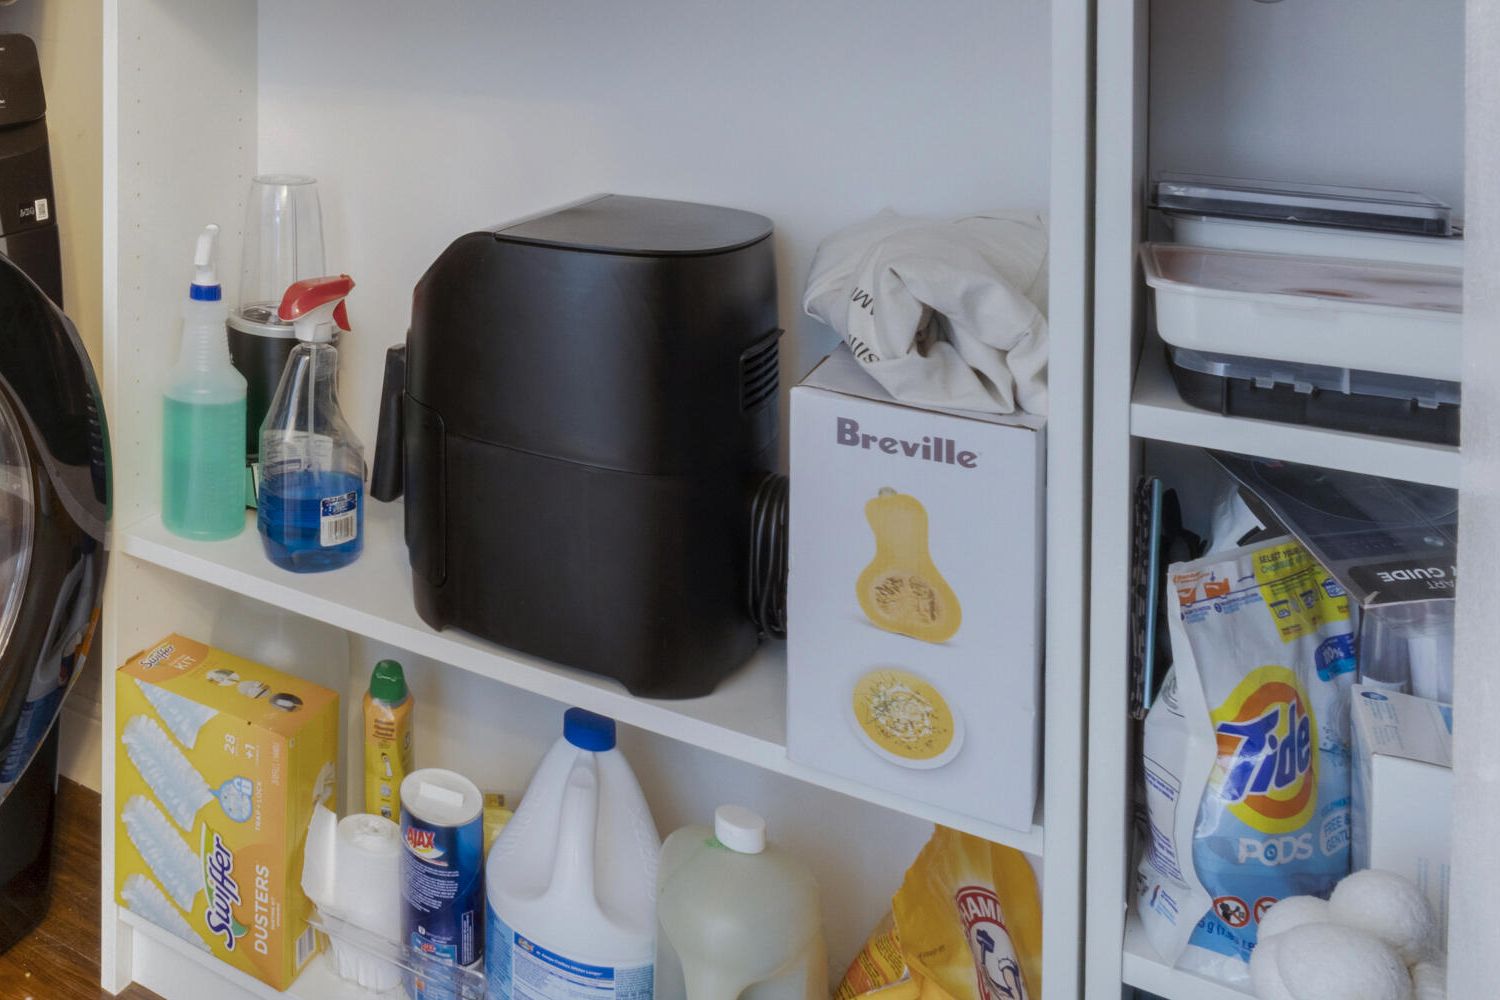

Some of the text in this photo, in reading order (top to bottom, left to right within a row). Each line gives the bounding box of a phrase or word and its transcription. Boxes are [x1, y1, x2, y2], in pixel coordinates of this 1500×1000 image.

[837, 417, 978, 469] Breville
[1377, 567, 1445, 582] GUIDE
[139, 644, 175, 670] Swiffer
[175, 654, 197, 670] KIT
[225, 733, 236, 755] 28
[1216, 702, 1311, 803] Tide
[407, 826, 436, 849] AJAX
[1238, 833, 1313, 866] PODS
[206, 833, 241, 951] Swiffer
[254, 864, 269, 955] DUSTERS
